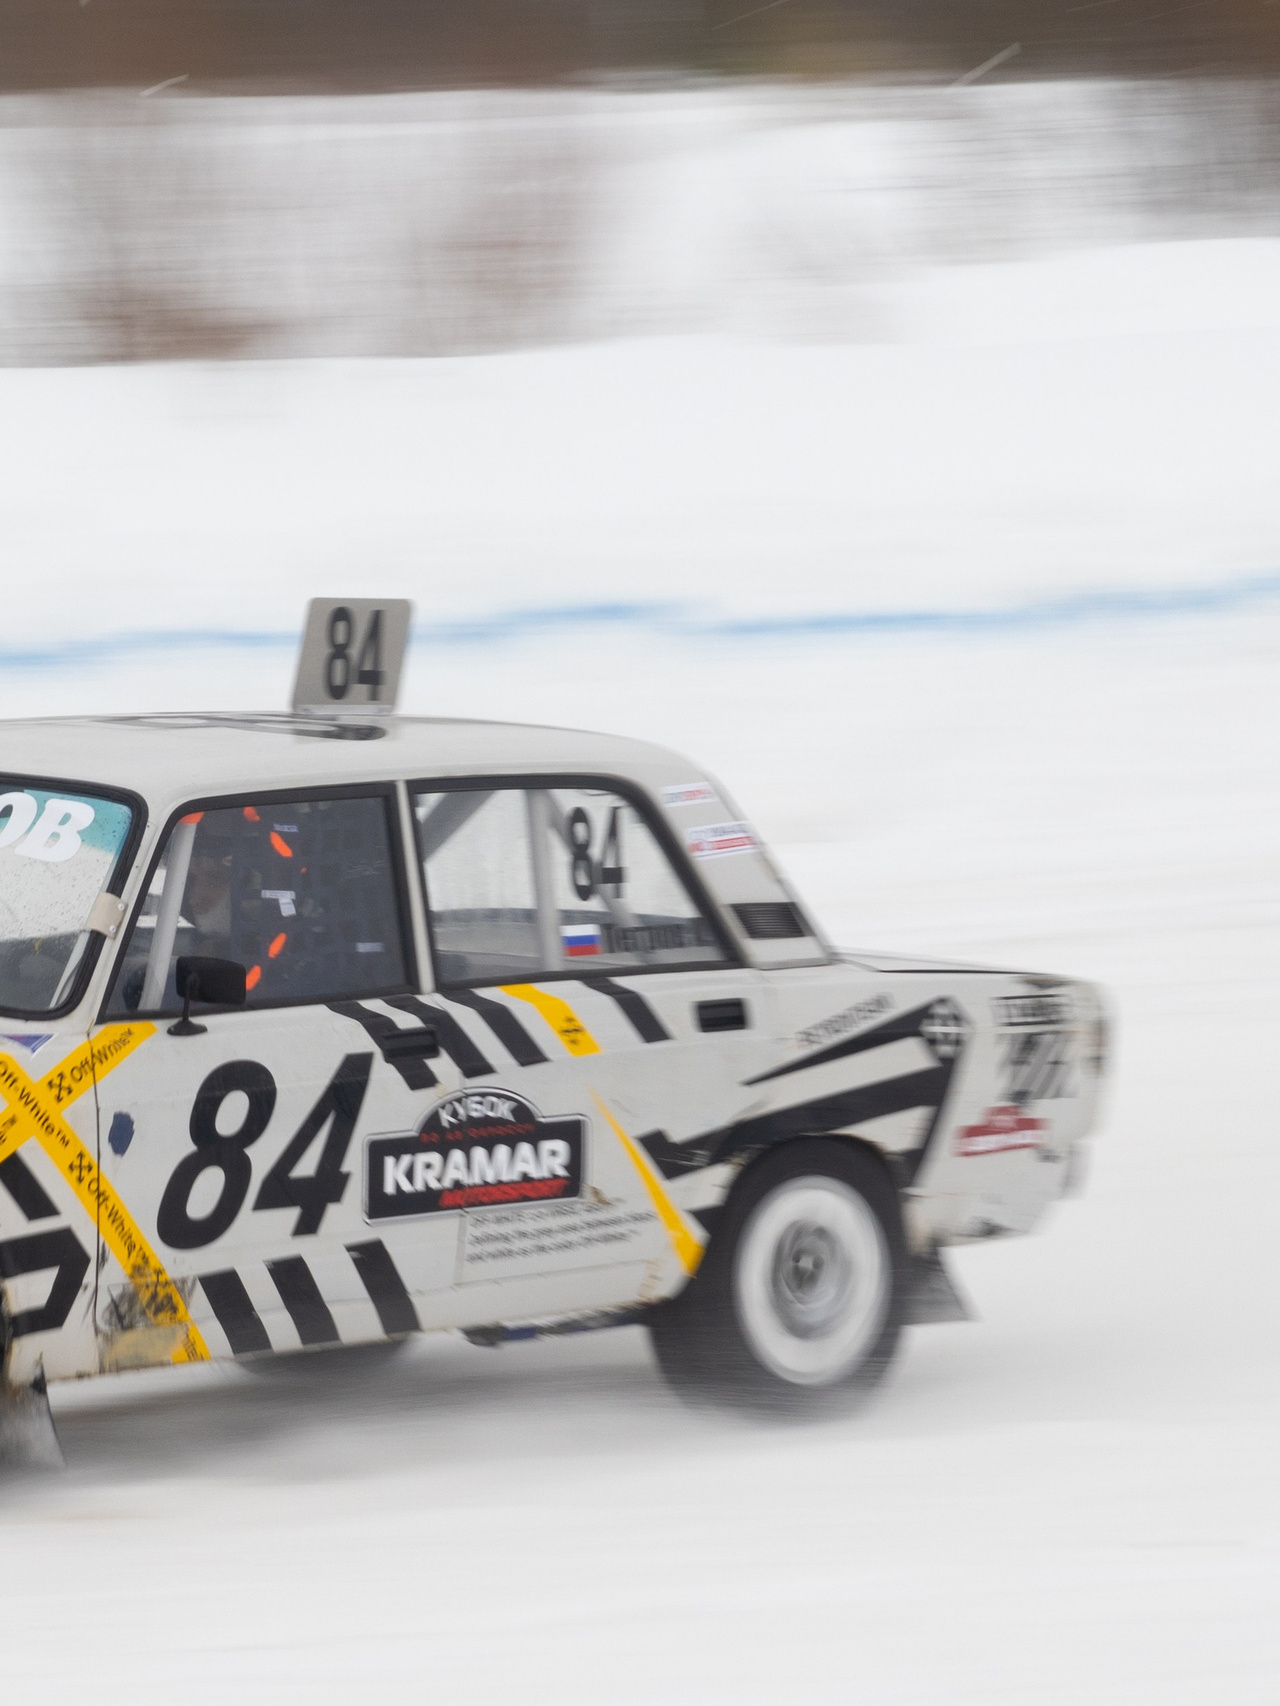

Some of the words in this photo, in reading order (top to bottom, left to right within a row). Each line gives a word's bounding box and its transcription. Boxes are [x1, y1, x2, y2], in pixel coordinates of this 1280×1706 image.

[324, 606, 386, 701] 84
[568, 806, 627, 901] 84
[157, 1052, 375, 1250] 84
[383, 1139, 571, 1196] KRAMAR
